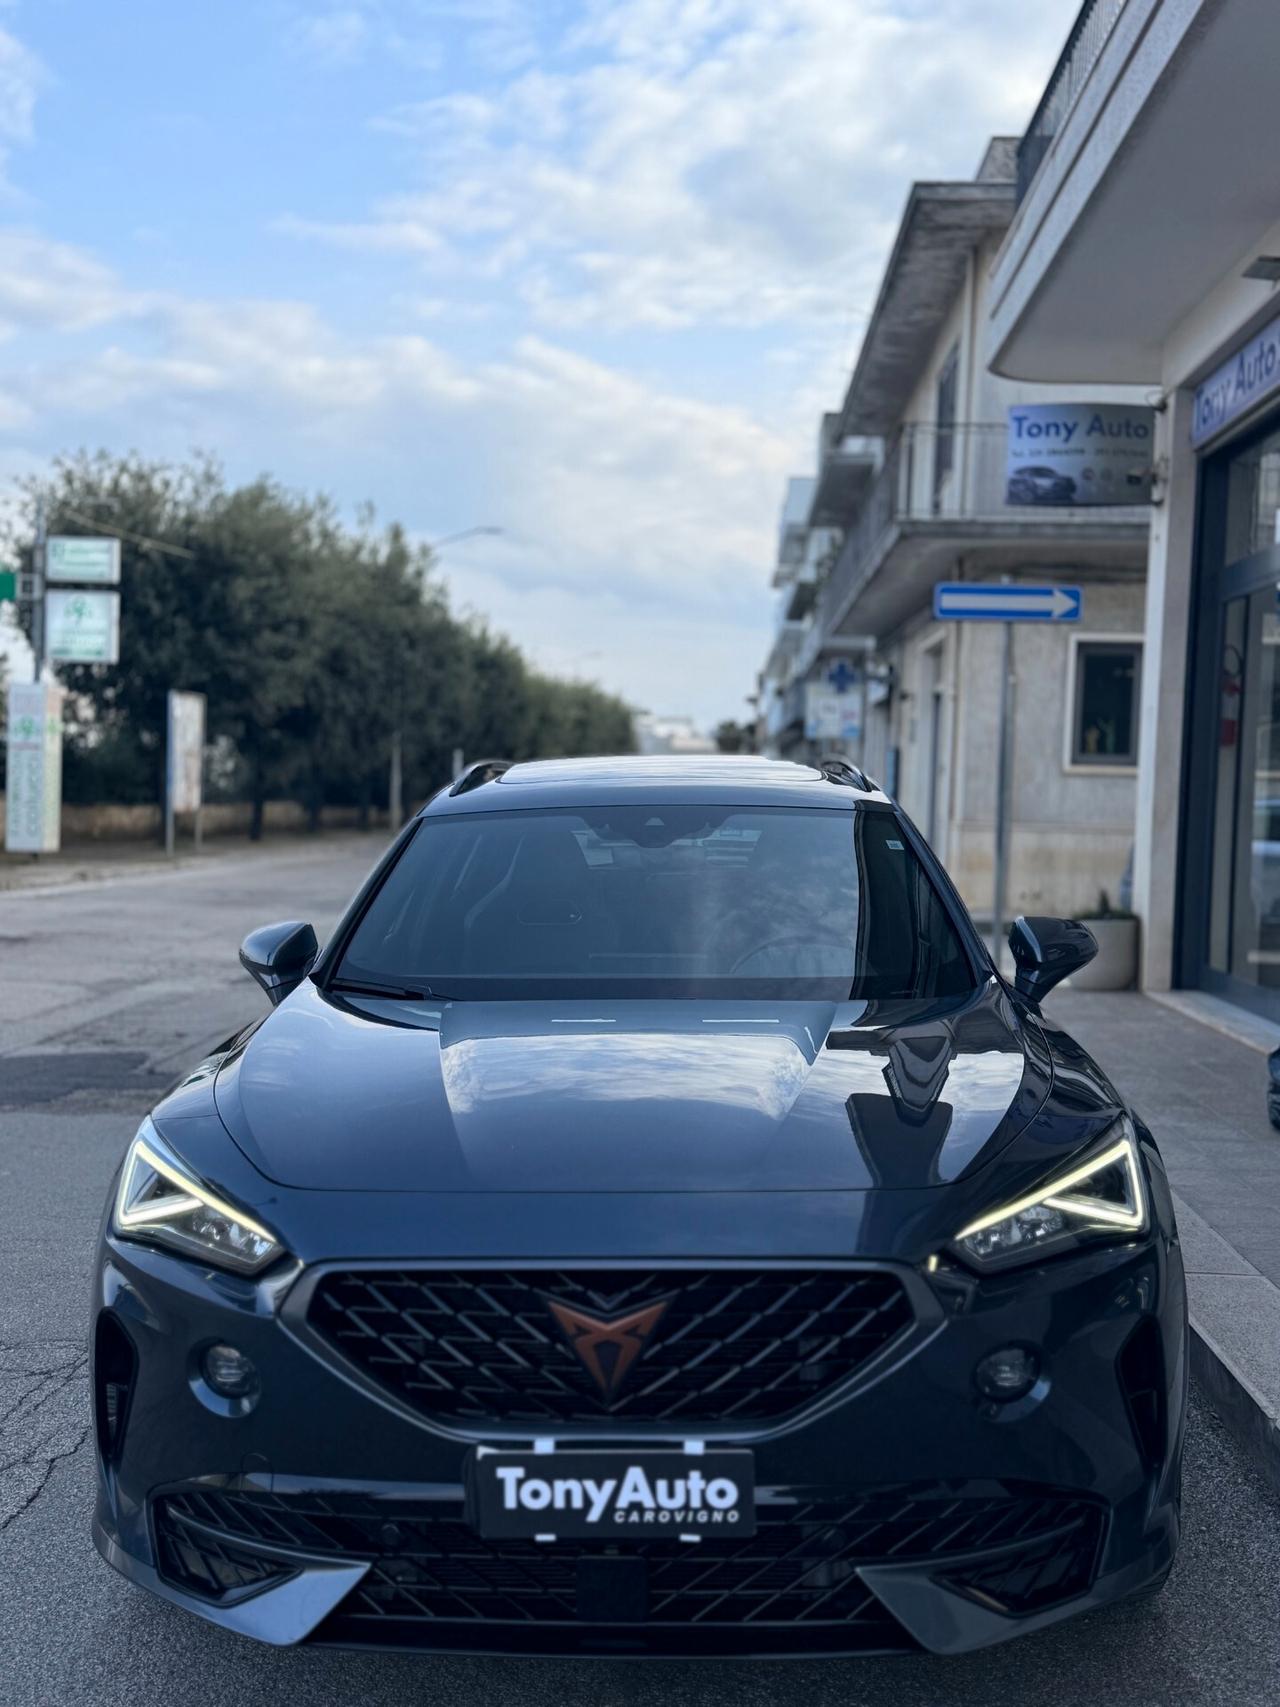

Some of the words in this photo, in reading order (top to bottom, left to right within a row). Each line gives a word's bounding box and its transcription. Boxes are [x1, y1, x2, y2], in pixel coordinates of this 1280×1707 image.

[1195, 377, 1231, 433] Tony
[1234, 338, 1276, 403] Auto
[1013, 415, 1078, 443] Tony
[1087, 413, 1149, 439] Auto
[614, 1511, 739, 1523] CAROVIGNO
